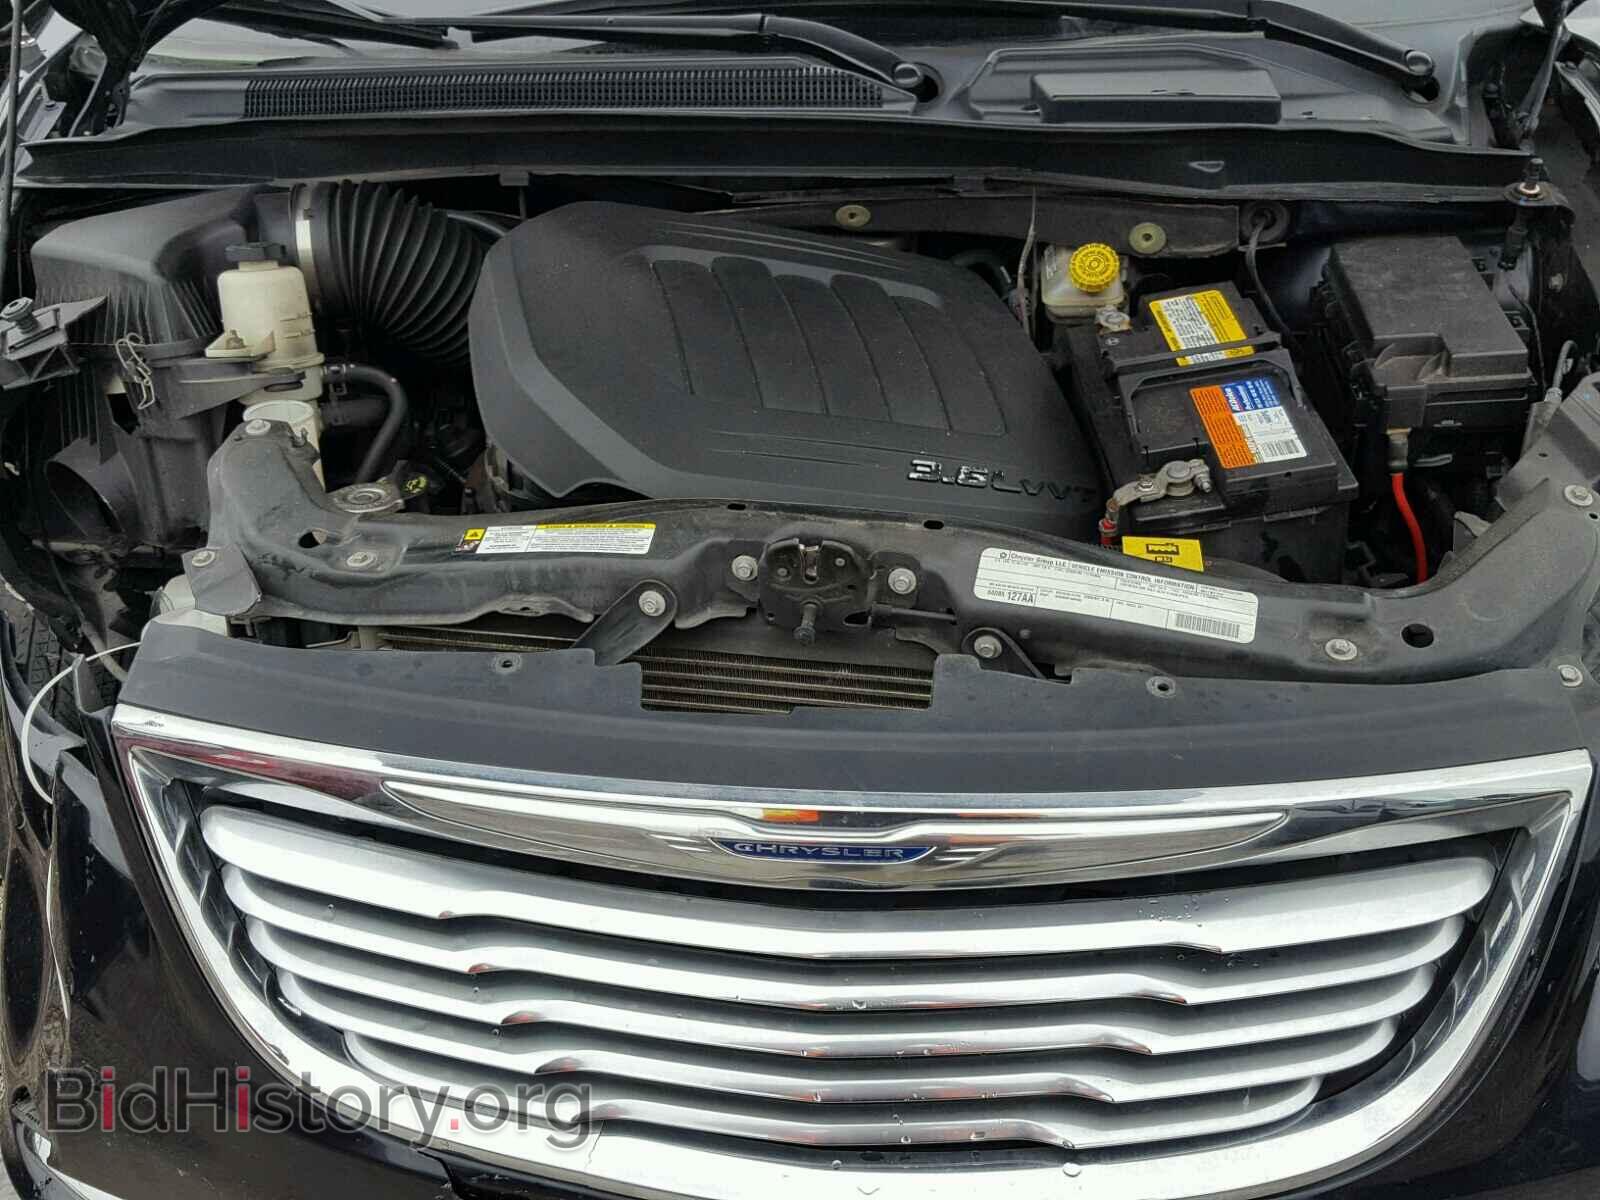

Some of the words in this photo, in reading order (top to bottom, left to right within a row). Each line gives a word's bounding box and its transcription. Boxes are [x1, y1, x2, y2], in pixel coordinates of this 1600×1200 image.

[1126, 571, 1152, 581] CONTROL
[1154, 578, 1195, 589] INFORMATION
[1007, 591, 1034, 604] 127AA
[734, 842, 904, 858] CHRYSLER
